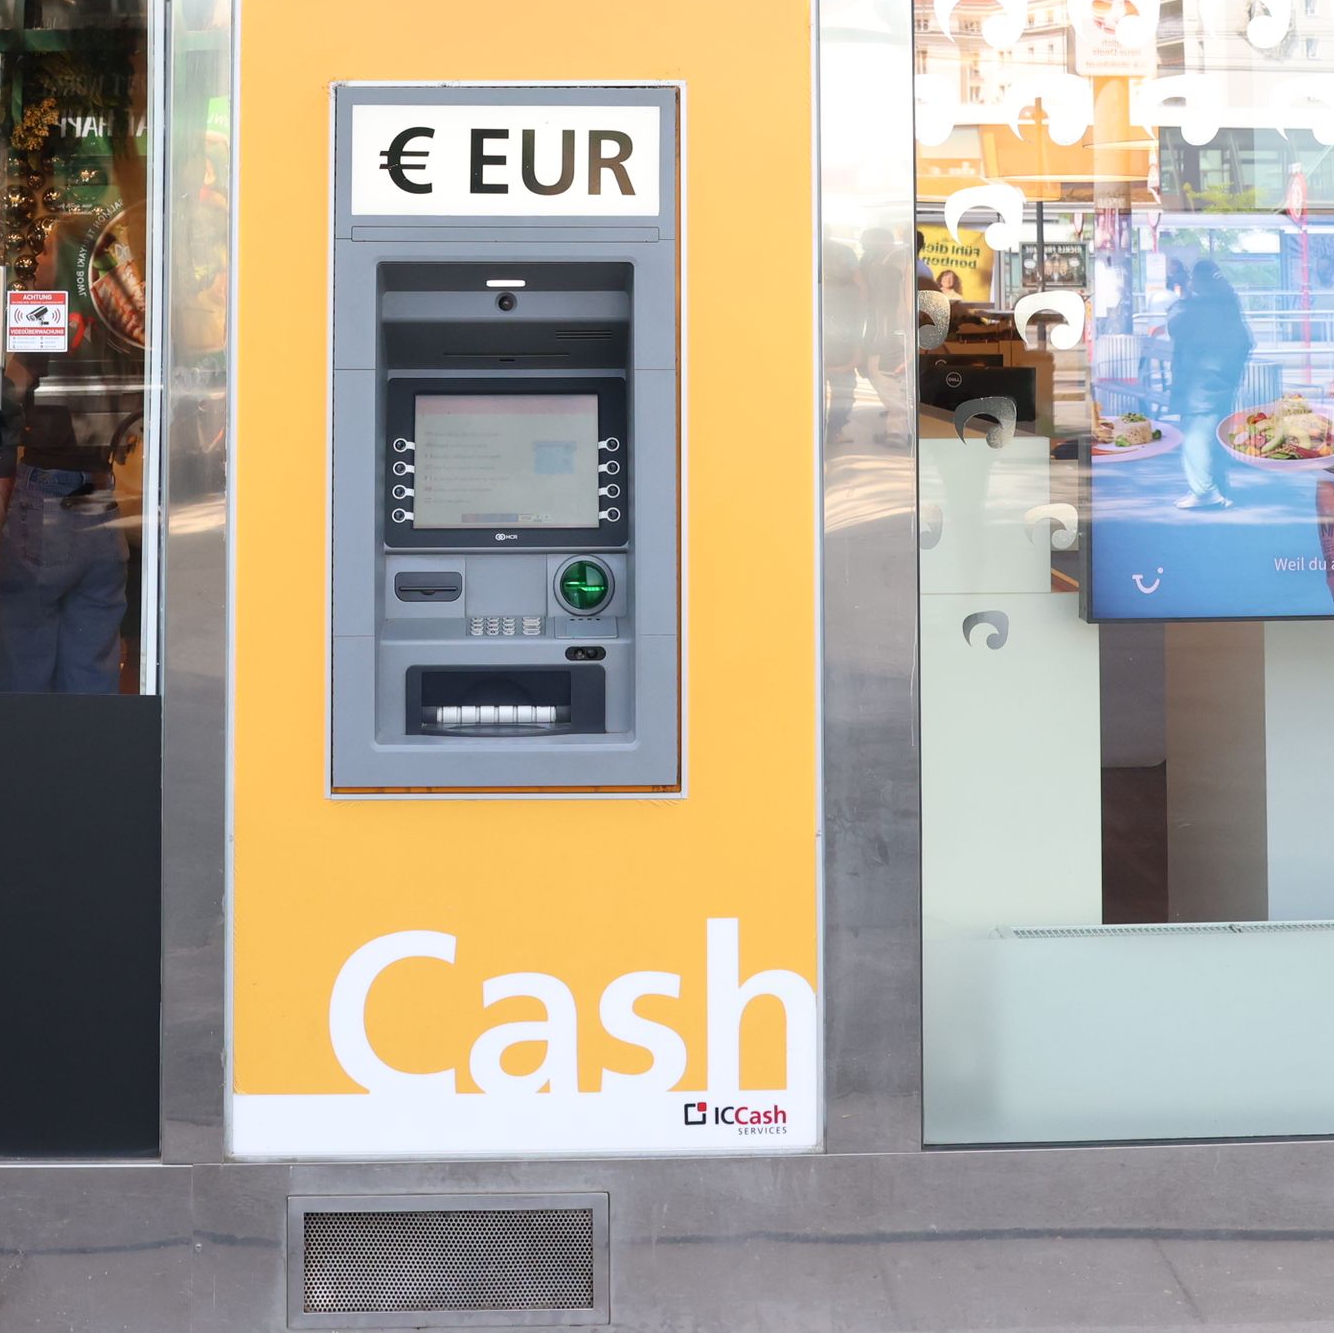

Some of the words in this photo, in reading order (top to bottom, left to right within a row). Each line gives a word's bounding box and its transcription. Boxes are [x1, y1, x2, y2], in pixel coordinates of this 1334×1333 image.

[378, 126, 436, 195] €
[470, 128, 637, 196] EUR
[1274, 556, 1305, 572] Weil
[1308, 556, 1328, 571] du
[328, 917, 816, 1094] Cash
[714, 1104, 788, 1126] ICCash
[738, 1126, 788, 1136] SERVICES
